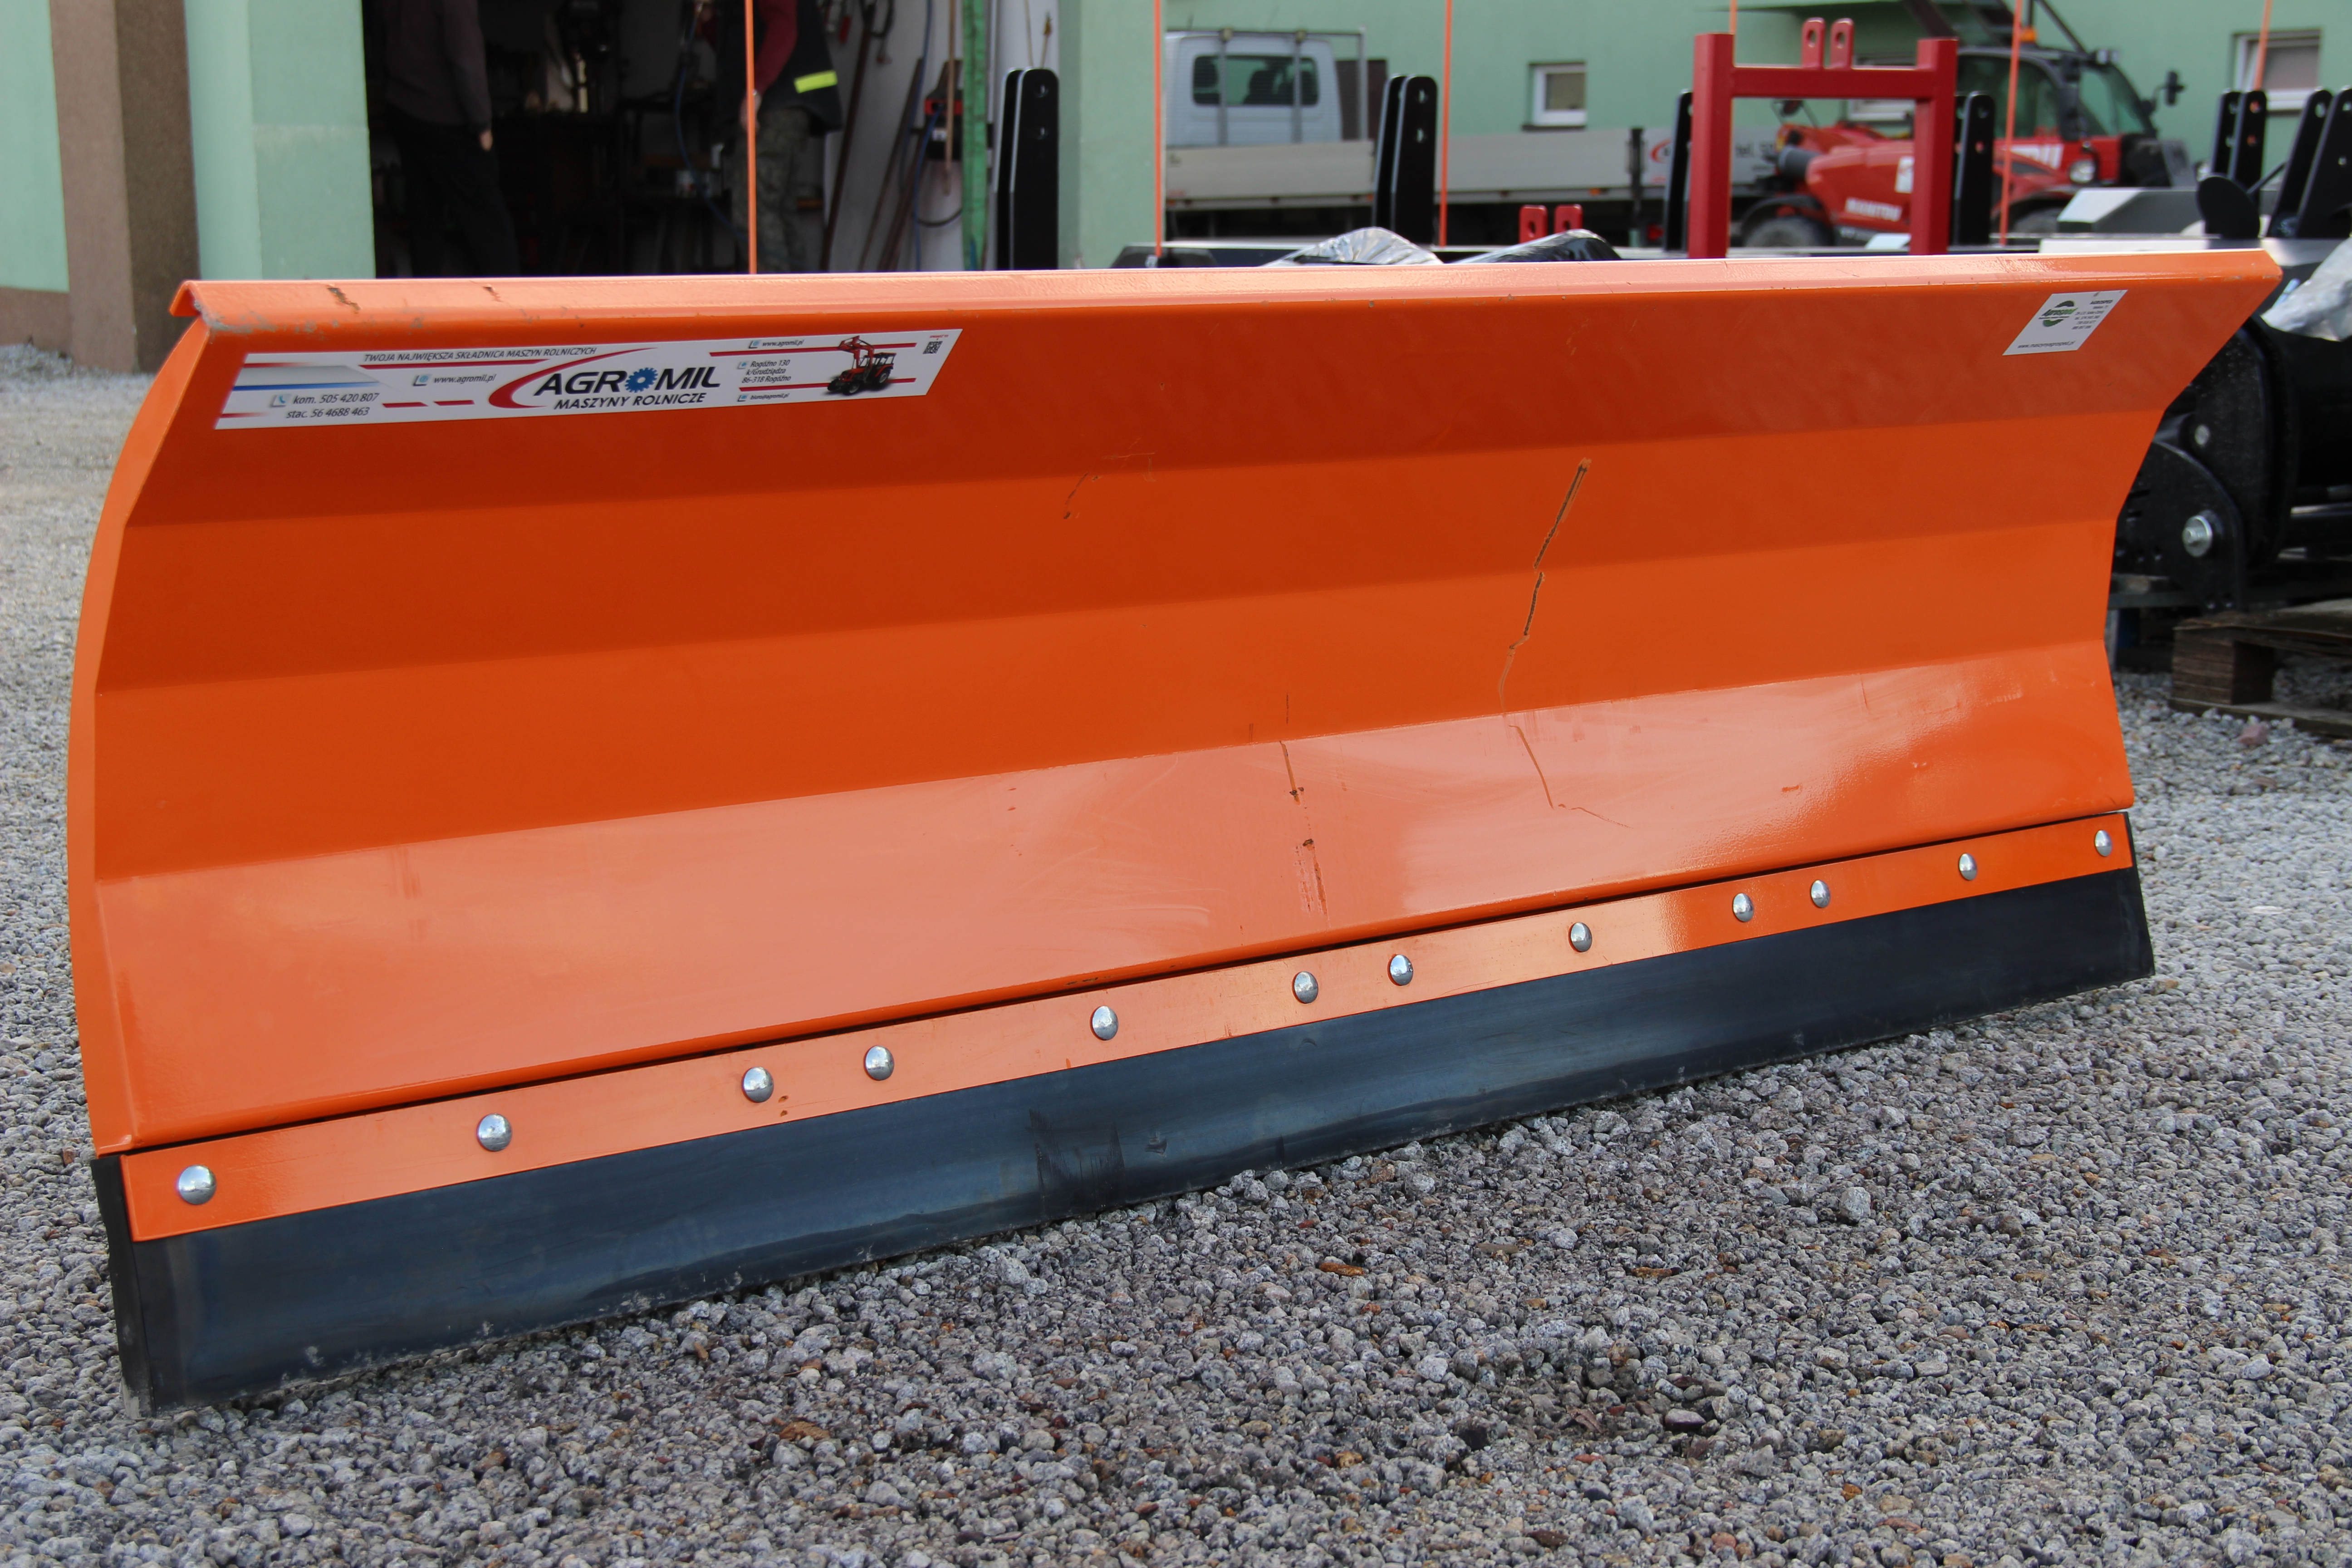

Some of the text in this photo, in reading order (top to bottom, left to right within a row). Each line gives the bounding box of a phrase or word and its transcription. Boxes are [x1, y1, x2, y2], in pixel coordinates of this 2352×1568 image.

[364, 348, 597, 362] TWOJA NAJWIĘKSZA SKŁADNICA MASZYN ROLNICZYCH
[750, 361, 777, 369] Rogóźno
[434, 374, 496, 385] www.agromil.pl
[293, 393, 380, 404] kom. 505 420 807
[554, 393, 707, 410] MASZYNY ROLNICZE
[286, 407, 370, 418] stac. 56 4688 463
